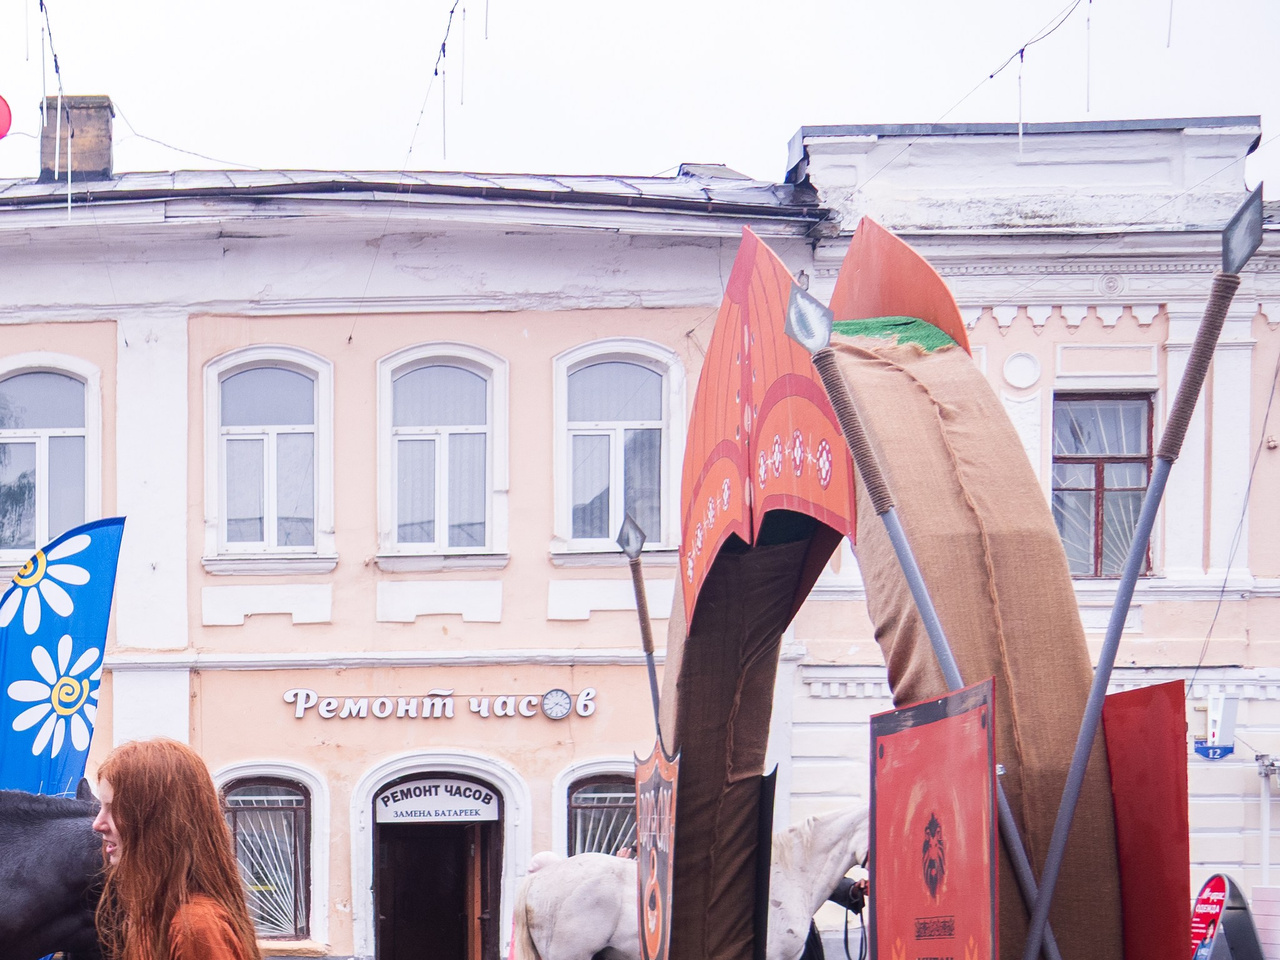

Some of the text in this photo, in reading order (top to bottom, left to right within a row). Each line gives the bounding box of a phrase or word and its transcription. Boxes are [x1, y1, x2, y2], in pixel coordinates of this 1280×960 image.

[282, 688, 454, 719] Ремонт
[1208, 748, 1221, 758] 12
[380, 785, 494, 807] РЕМОНТ ЧАСОВ
[393, 809, 481, 818] ЗАМЕНА БАТАРЕЕК
